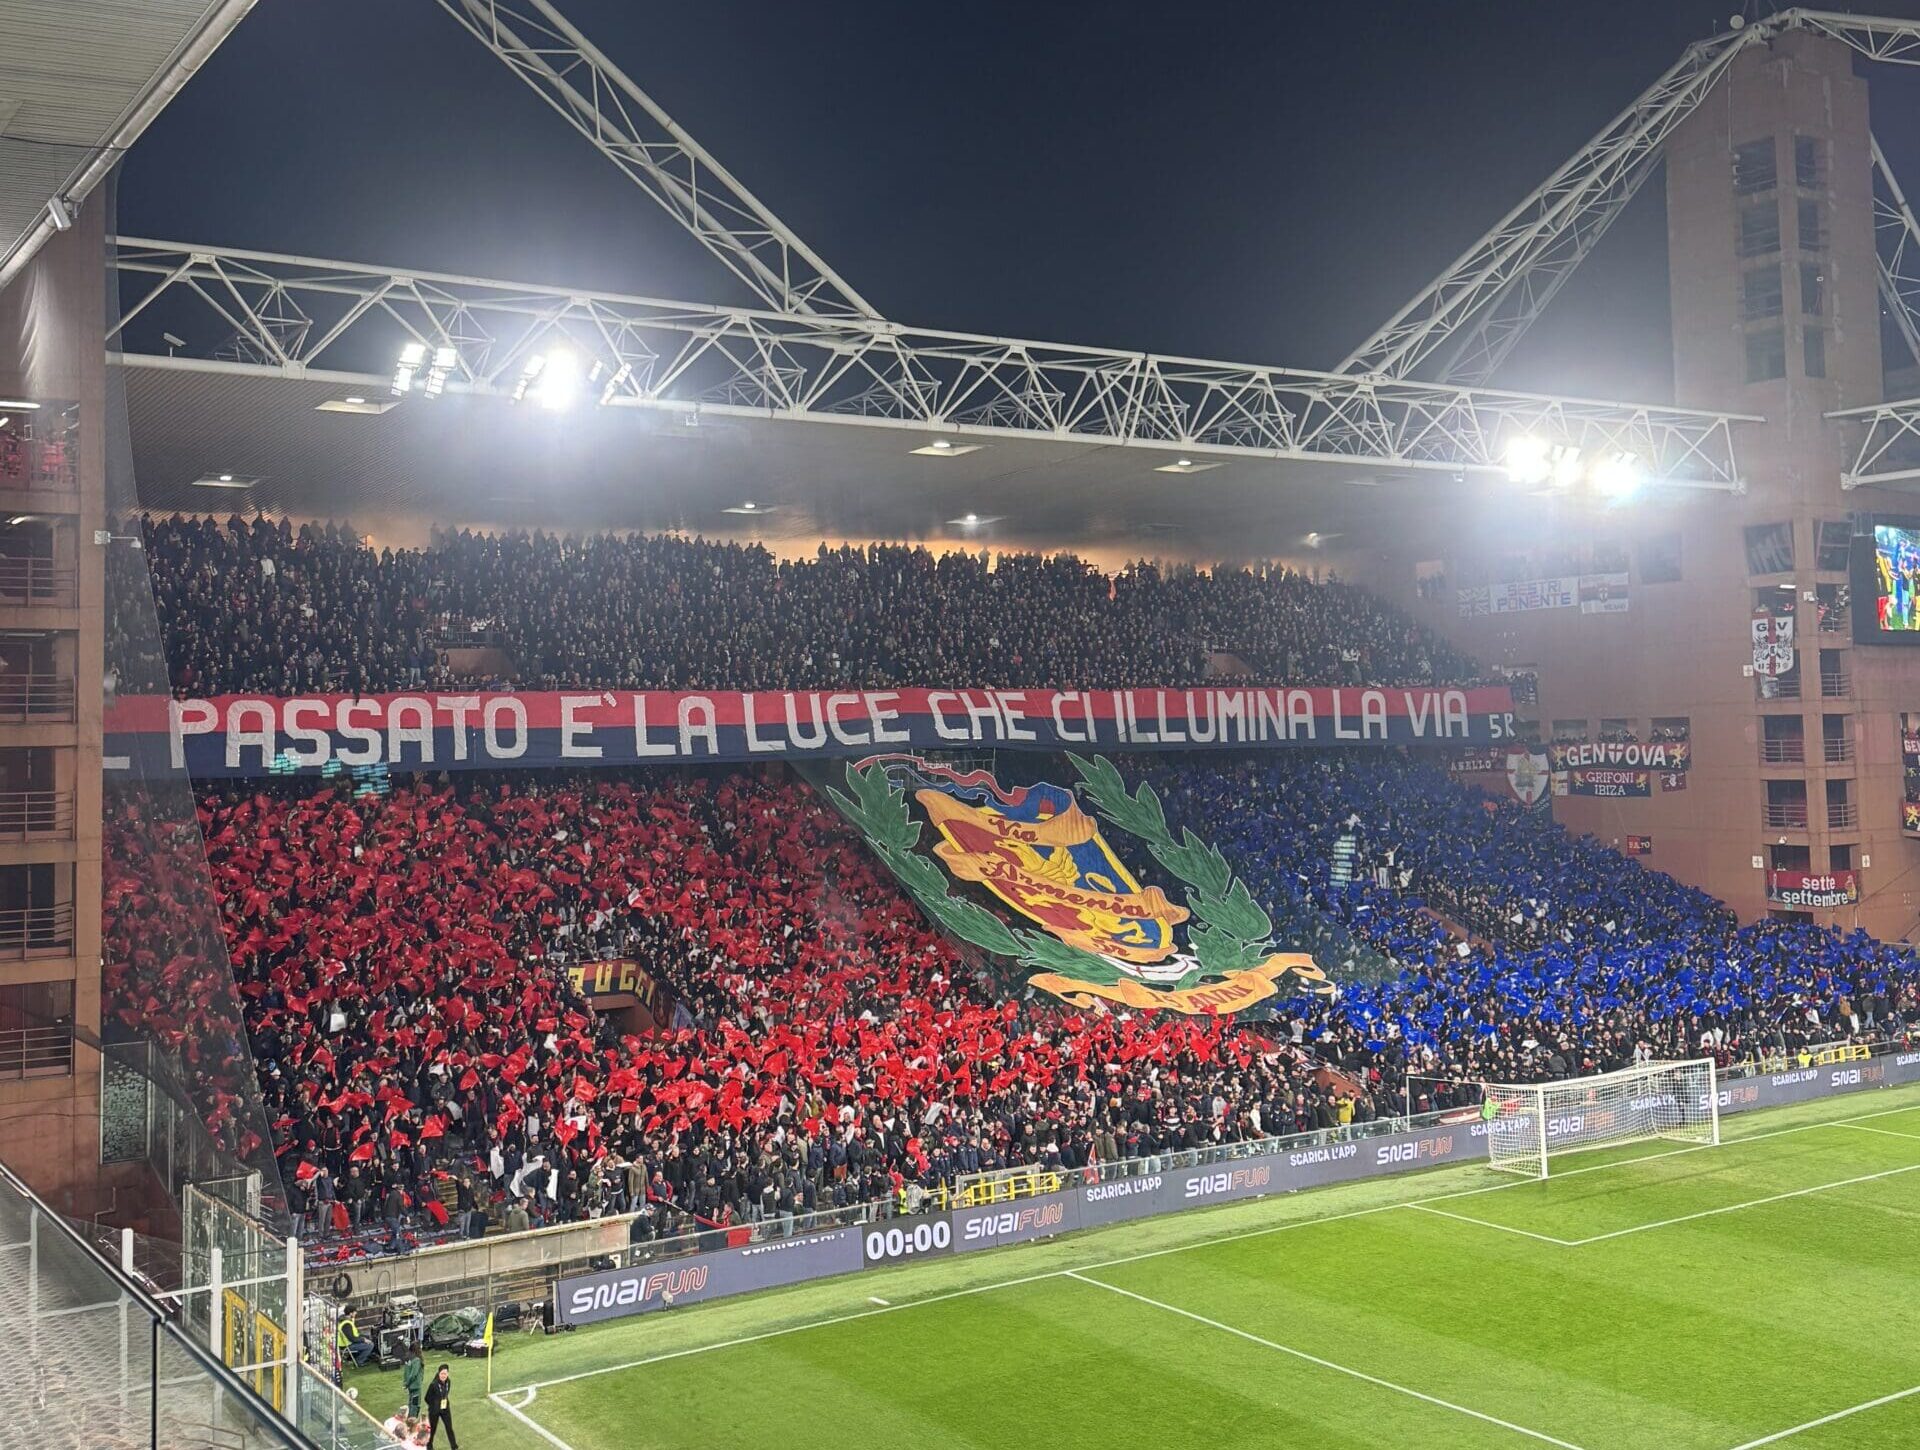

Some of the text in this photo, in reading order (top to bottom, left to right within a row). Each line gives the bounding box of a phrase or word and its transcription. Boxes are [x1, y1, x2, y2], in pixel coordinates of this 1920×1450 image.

[1497, 592, 1571, 612] PONENTE
[169, 696, 528, 768] PASSATO
[634, 694, 719, 756] LA
[741, 692, 911, 752] LUCE
[927, 691, 1037, 741] CHE
[1051, 692, 1098, 743] CI
[1113, 690, 1317, 743] ILLUMINA
[1332, 689, 1389, 740] LA
[1403, 690, 1470, 738] VIA
[1566, 743, 1667, 766] GENOVA
[1585, 771, 1634, 783] GRIFONI
[1594, 784, 1626, 796] IBIZA
[979, 861, 1152, 917] Armenia
[1801, 875, 1836, 891] sette
[1781, 889, 1849, 907] settembre
[1772, 1073, 1800, 1086] SCARICA
[1470, 1118, 1507, 1137] SCARICA
[1289, 1144, 1357, 1167] SCARICA L'APP
[1086, 1176, 1162, 1203] SCARICA L'APP
[866, 1220, 951, 1260] 00:00
